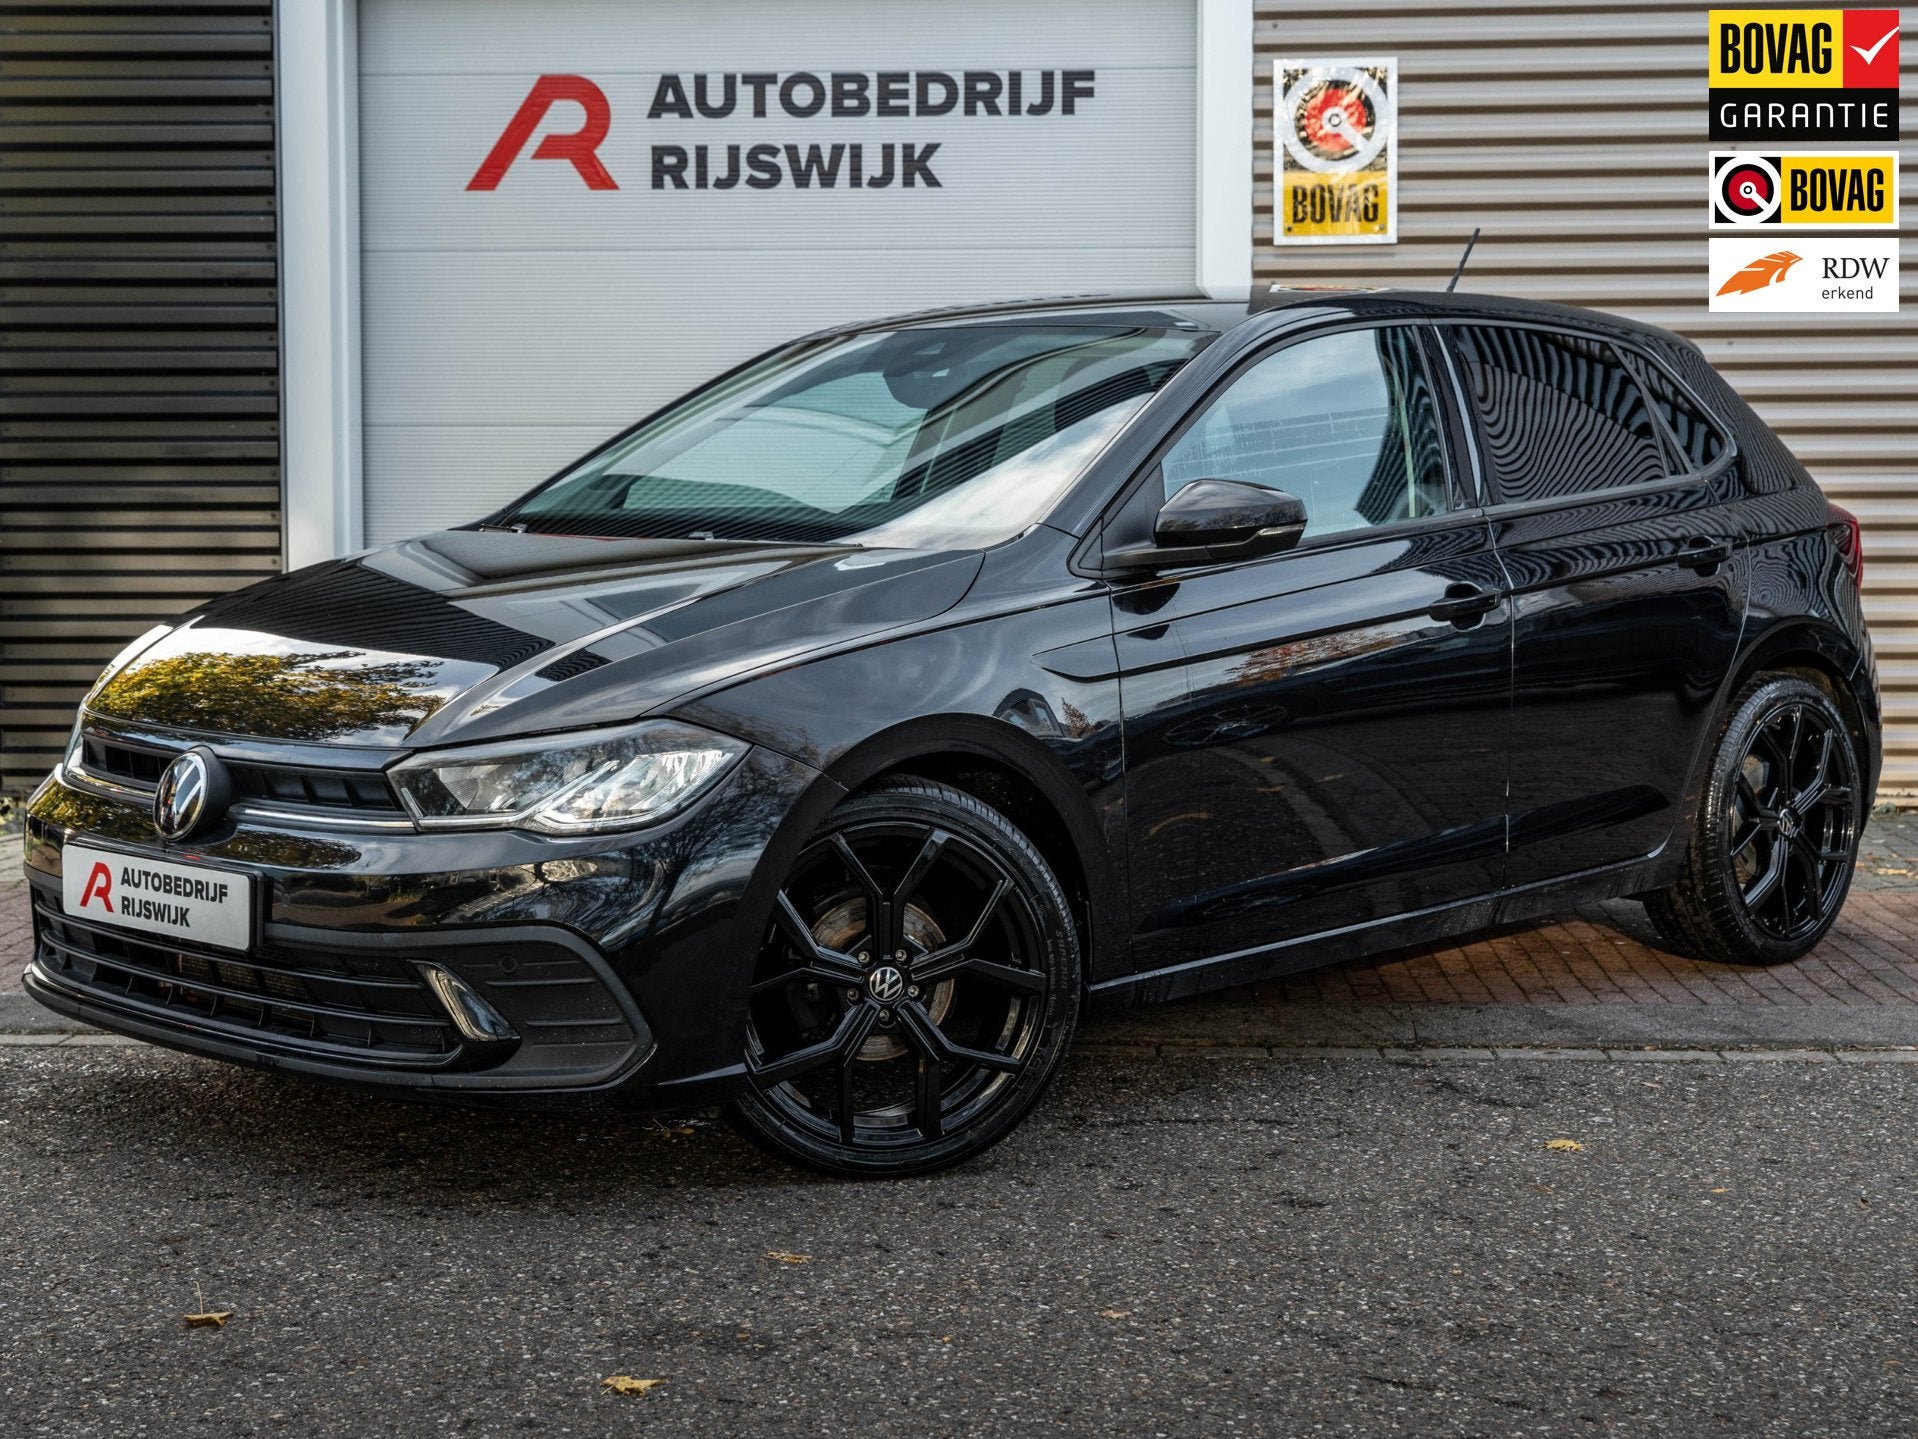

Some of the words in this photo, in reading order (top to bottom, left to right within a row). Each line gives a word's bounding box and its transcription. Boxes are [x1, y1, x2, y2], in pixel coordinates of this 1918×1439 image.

[646, 70, 1096, 119] AUTOBEDRIJF
[650, 142, 943, 190] RIJSWIJK
[1292, 183, 1379, 224] BOVAG
[120, 867, 228, 904] AUTOBEDRIJF
[121, 895, 191, 928] RIJSWIJK
